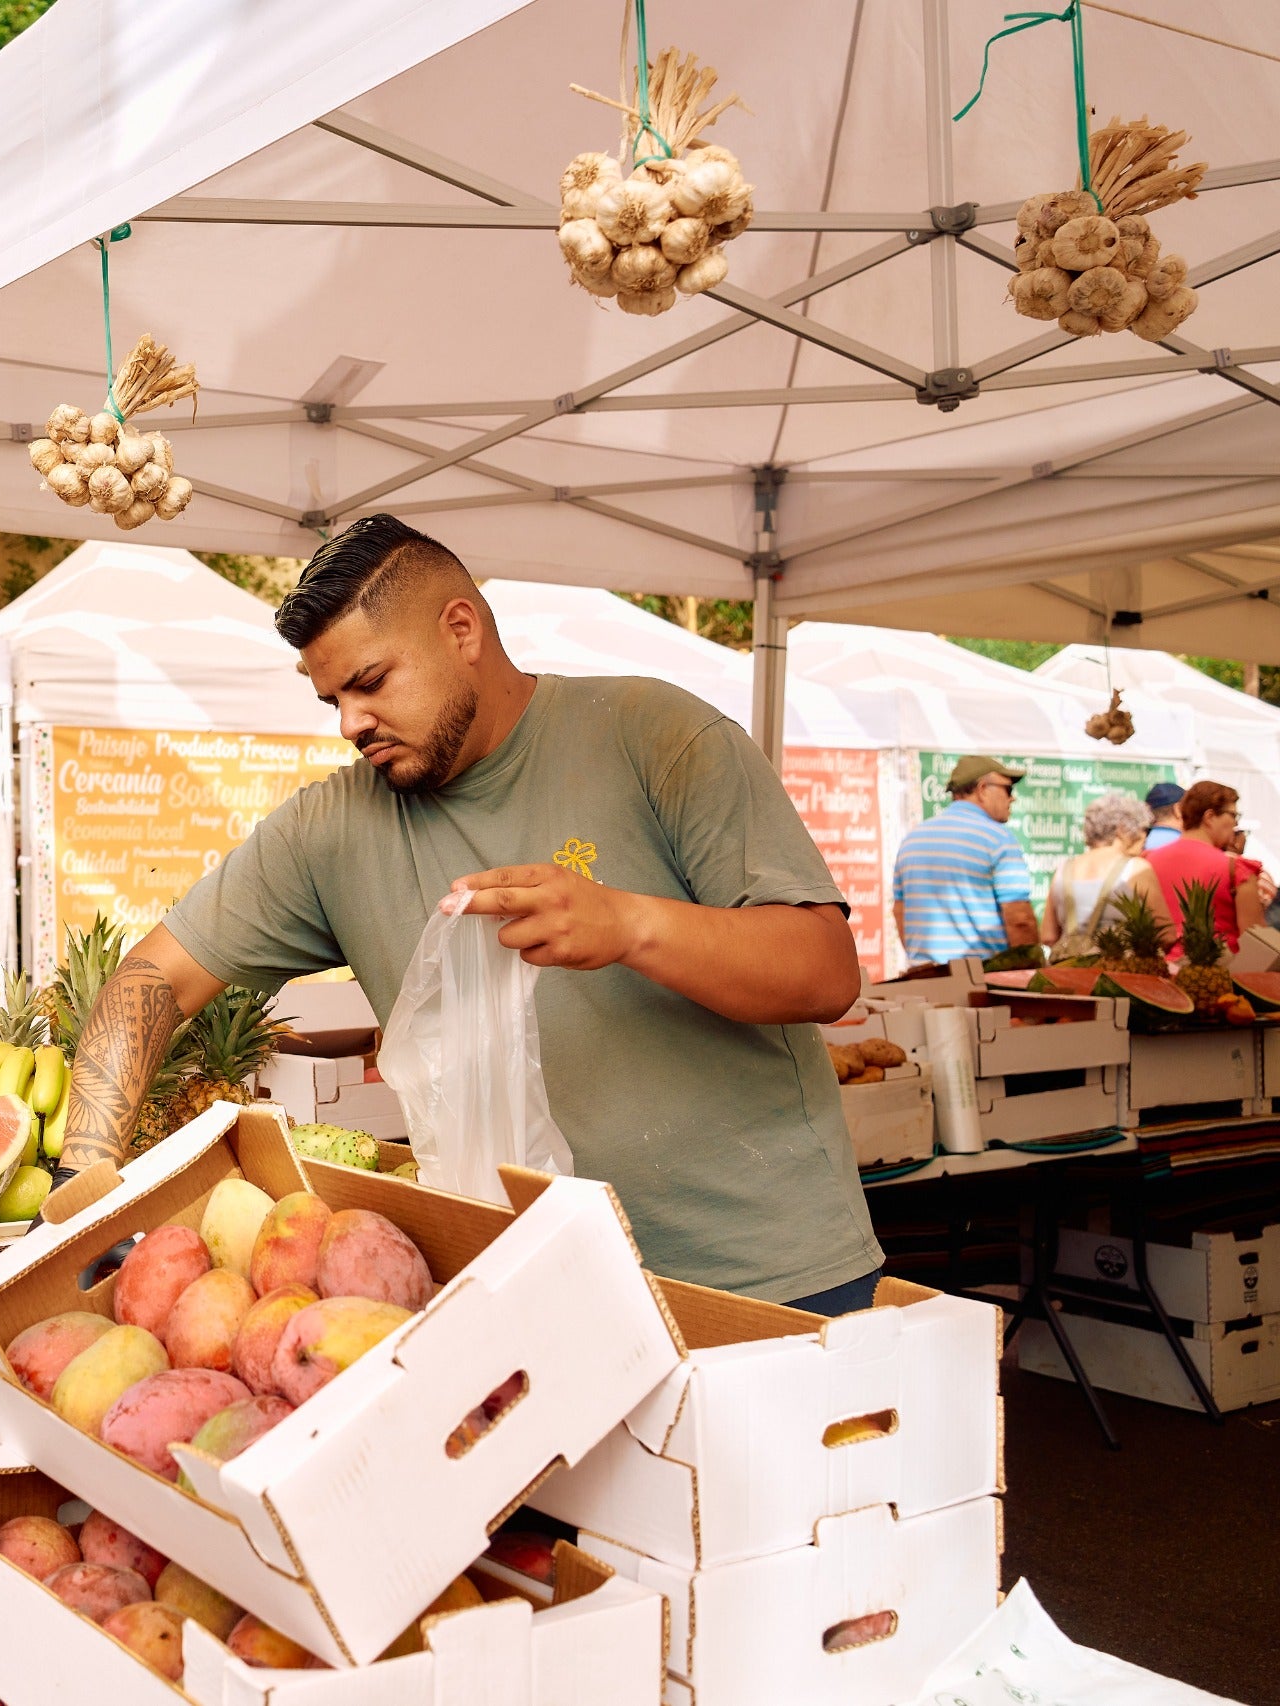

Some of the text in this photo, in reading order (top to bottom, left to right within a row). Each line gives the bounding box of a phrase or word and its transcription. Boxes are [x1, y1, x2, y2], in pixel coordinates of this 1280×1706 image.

[78, 729, 149, 767] Paisaje
[155, 731, 301, 761] Productos Frescos
[58, 759, 166, 795] Cercanía
[146, 818, 186, 841] local
[61, 850, 128, 875] Calidad
